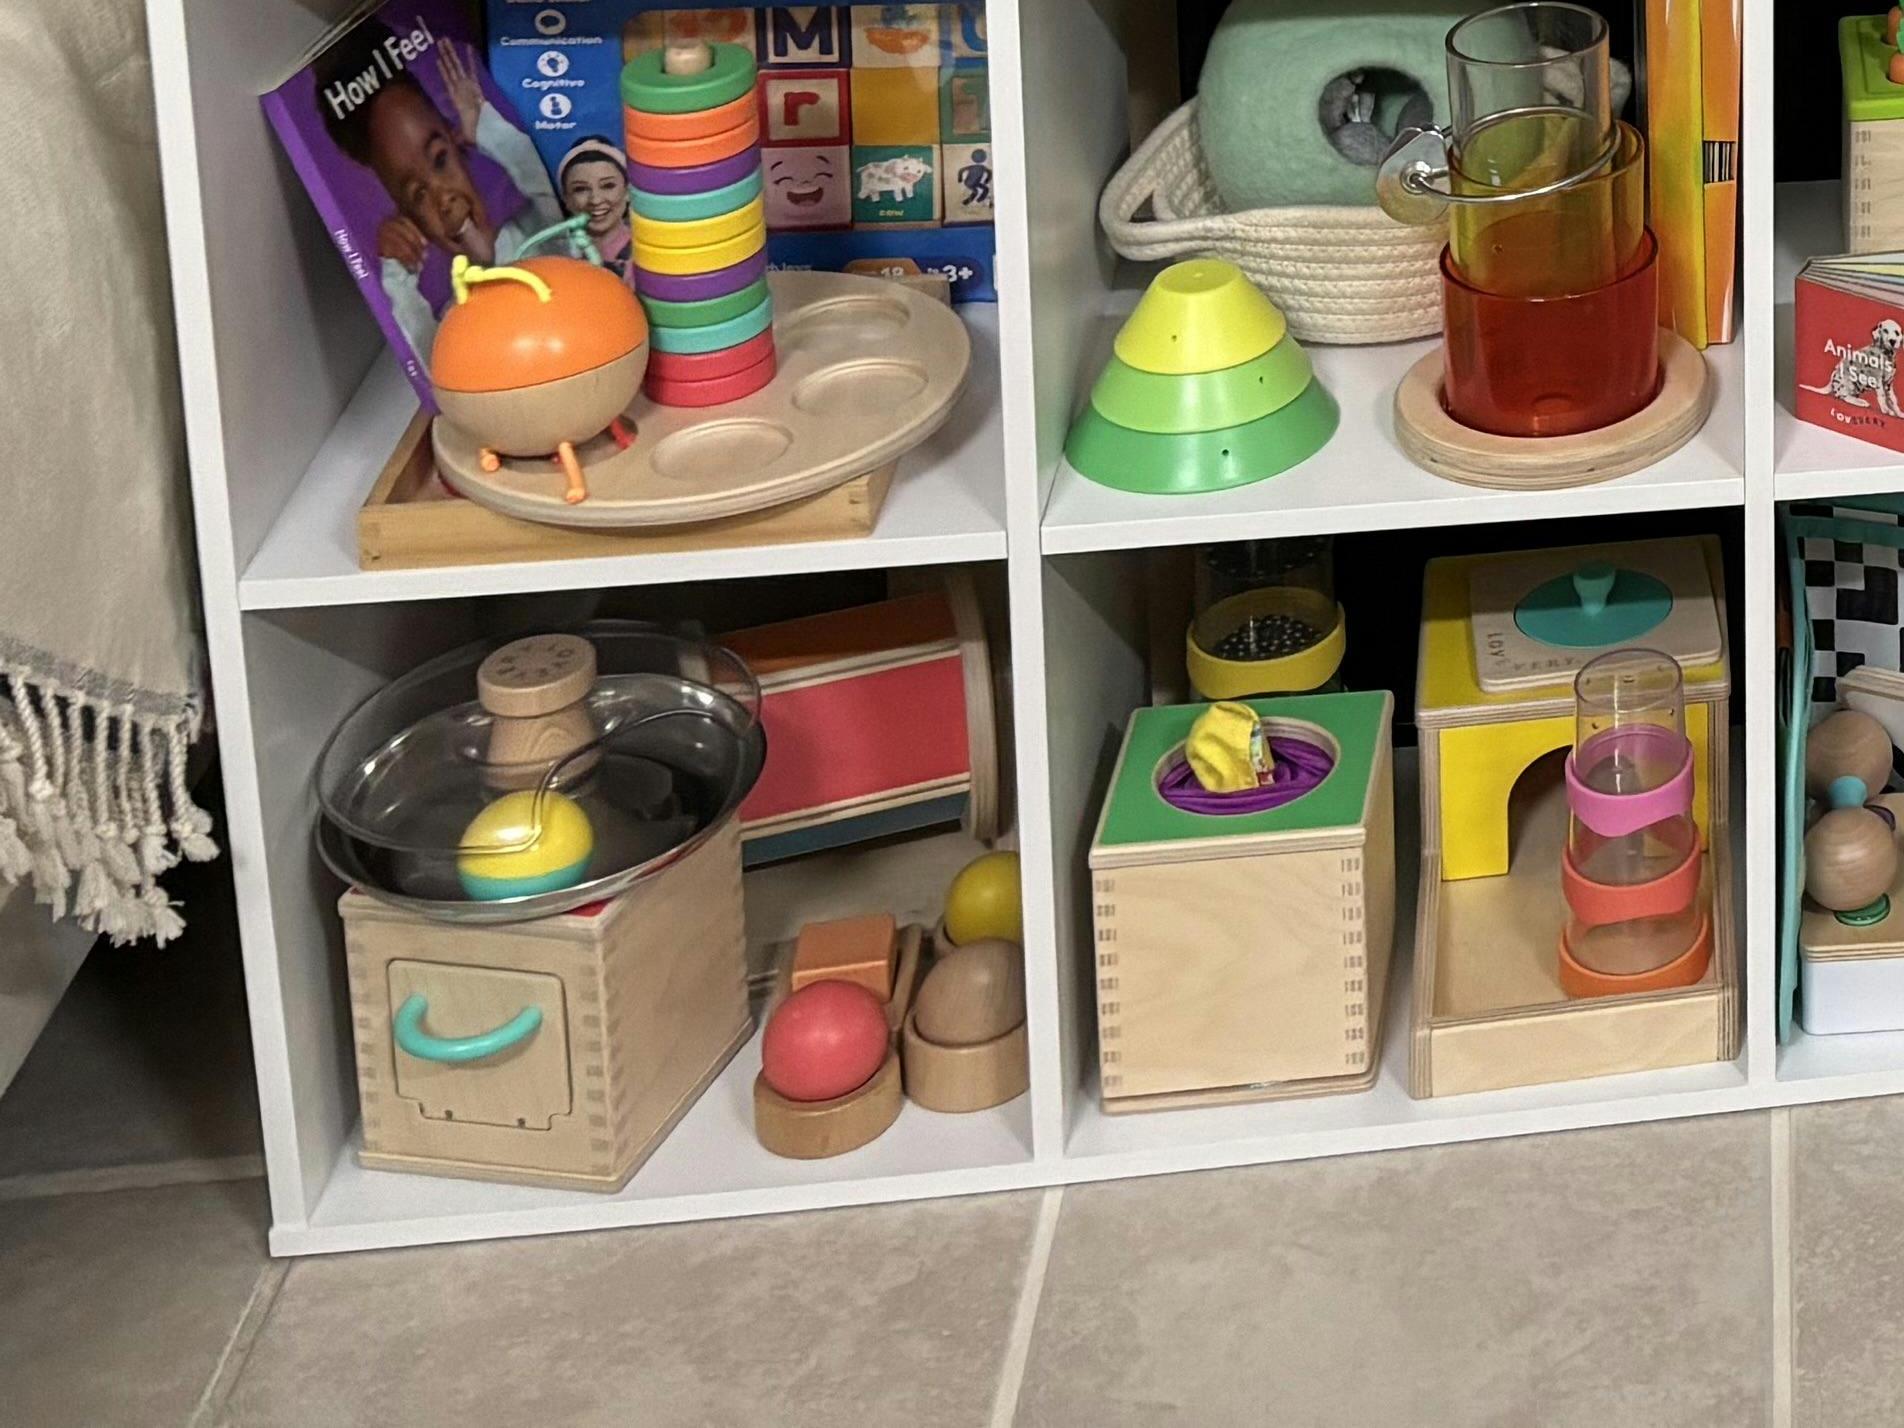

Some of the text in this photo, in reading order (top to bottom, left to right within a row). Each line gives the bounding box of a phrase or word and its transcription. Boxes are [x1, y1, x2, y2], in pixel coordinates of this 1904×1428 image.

[500, 36, 602, 46] Communication
[772, 6, 834, 57] M
[324, 15, 434, 120] How I Feel
[521, 78, 585, 90] Cognitive
[535, 120, 576, 130] Motor
[942, 266, 973, 282] 3+
[1824, 339, 1892, 372] Animals
[1840, 362, 1877, 387] I See
